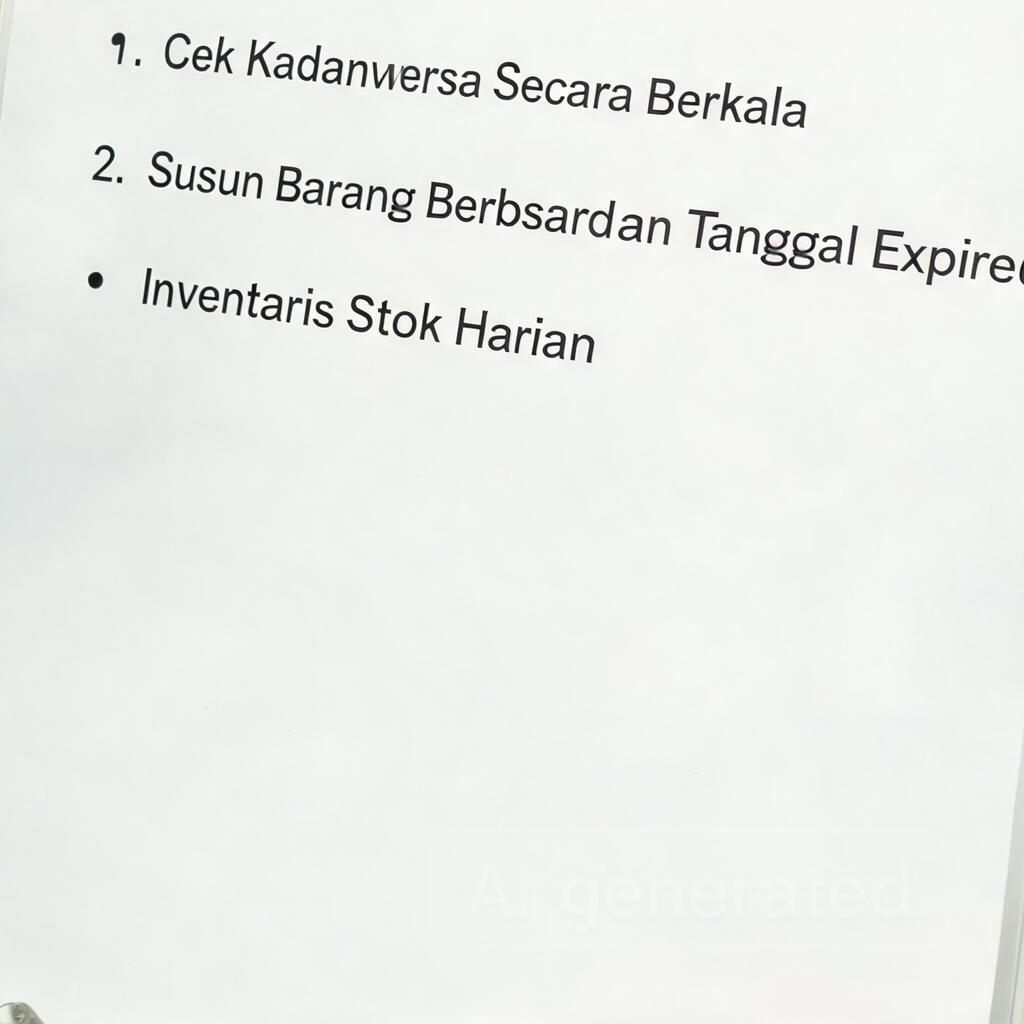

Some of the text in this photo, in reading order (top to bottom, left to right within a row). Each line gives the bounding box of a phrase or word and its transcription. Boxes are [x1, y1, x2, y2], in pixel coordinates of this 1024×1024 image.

[164, 32, 235, 75] Cek
[246, 39, 481, 98] Kadanwersa
[493, 61, 632, 113] Secara
[646, 77, 807, 129] Berkala
[91, 144, 1024, 286] 2. Susun Barang Berbsardan Tanggal Expire
[141, 267, 595, 364] Inventaris Stok Harian
